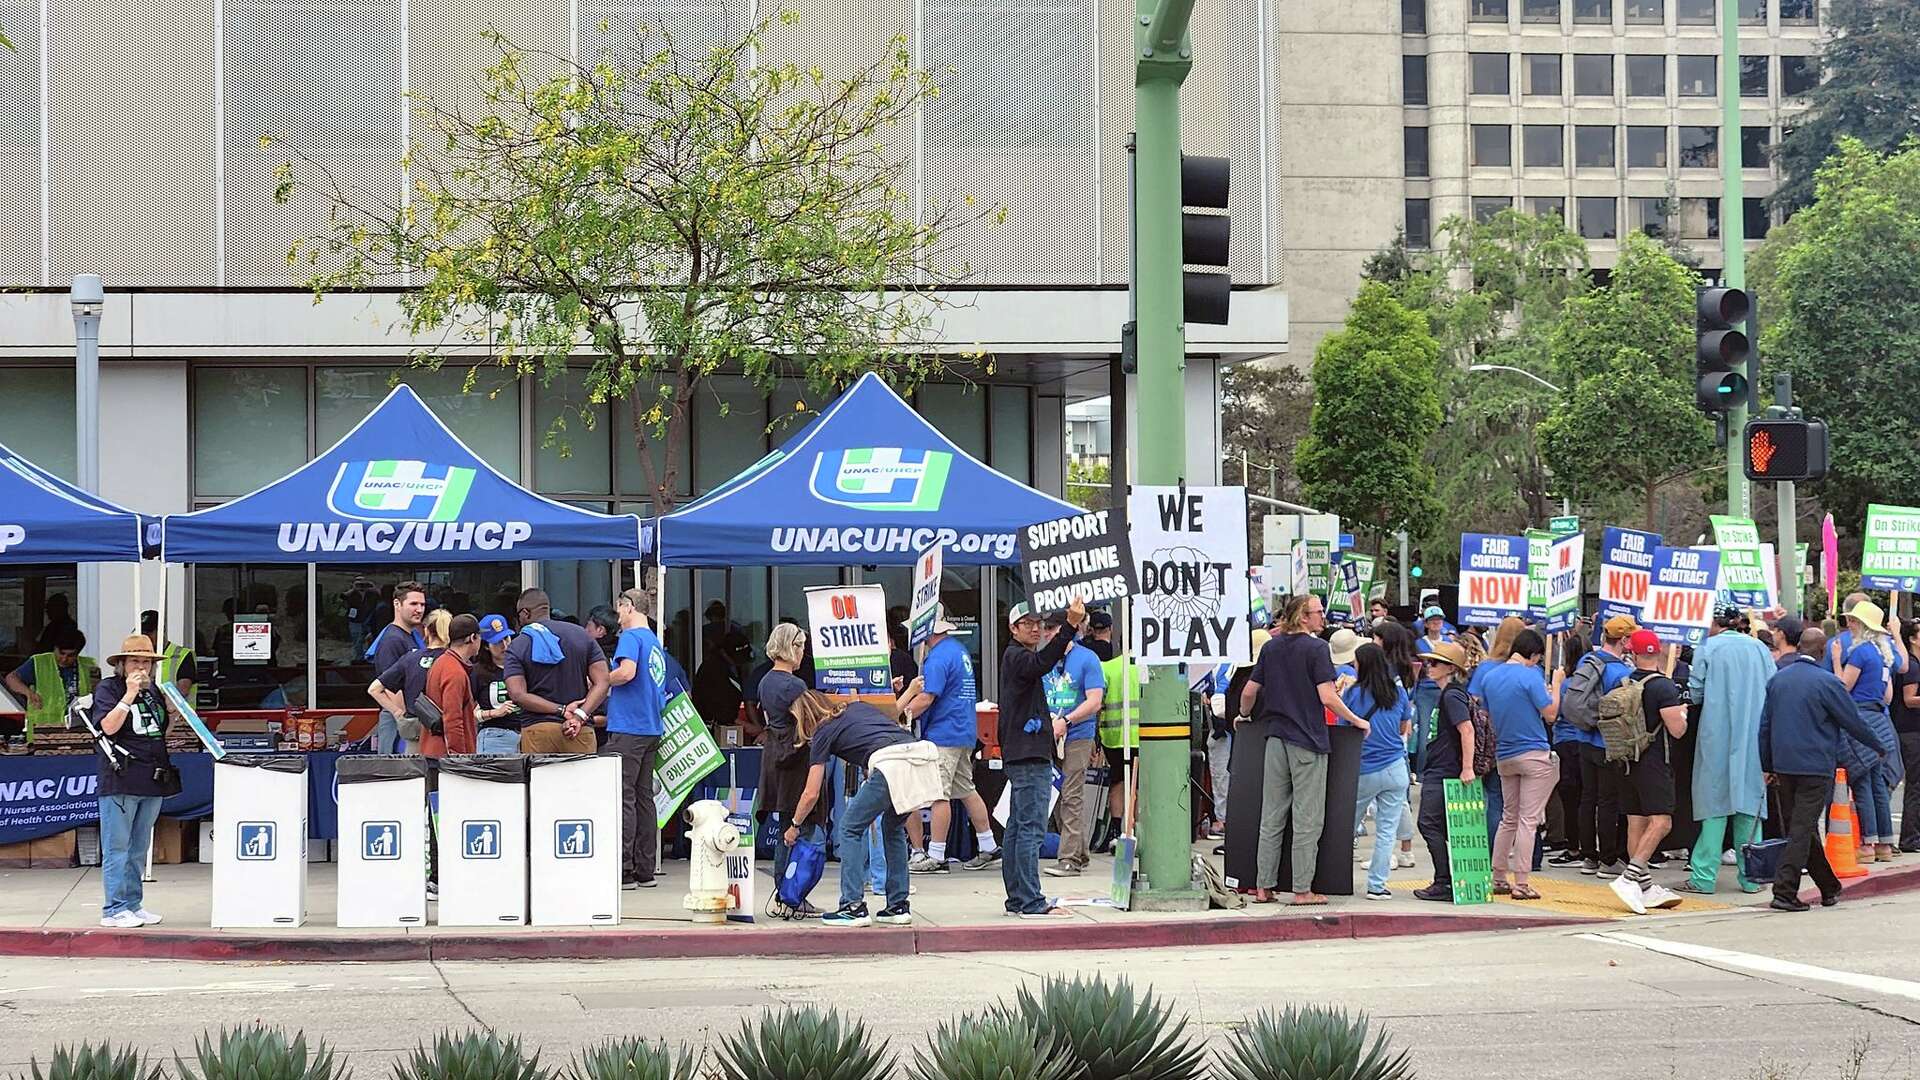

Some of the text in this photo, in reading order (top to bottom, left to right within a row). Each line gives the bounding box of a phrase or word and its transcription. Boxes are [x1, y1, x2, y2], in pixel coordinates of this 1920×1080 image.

[843, 466, 921, 474] UNAC/UHCP
[364, 481, 443, 490] UNAC/UHCP
[1158, 494, 1203, 532] WE
[1874, 519, 1888, 531] On
[277, 522, 532, 553] UNAC/UHCP
[1028, 511, 1108, 550] SUPPORT
[1620, 533, 1645, 552] FAIR
[771, 528, 1016, 558] UNACUHCP.org
[1481, 538, 1510, 556] FAIR
[1029, 545, 1120, 584] FRONTLINE
[1470, 554, 1521, 570] CONTRACT
[1559, 547, 1571, 570] ON
[1610, 548, 1654, 567] CONTRACT
[1671, 551, 1700, 570] FAIR
[1142, 561, 1232, 596] DON'T
[1551, 570, 1576, 597] STRIKE
[1608, 570, 1648, 603] NOW
[1659, 568, 1709, 584] CONTRACT
[916, 576, 938, 611] STRIKE
[1033, 574, 1129, 614] PROVIDERS
[1469, 576, 1521, 605] NOW
[831, 594, 859, 620] ON
[1654, 591, 1709, 621] NOW
[820, 624, 879, 648] STRIKE
[1141, 617, 1236, 657] PLAY
[666, 742, 709, 781] On Strike
[4, 801, 98, 815] Nurses Associations
[11, 815, 42, 826] Health
[45, 814, 67, 823] Care
[1450, 835, 1488, 849] OPERATE
[726, 855, 749, 879] STRI
[1453, 858, 1489, 873] WITHOUT
